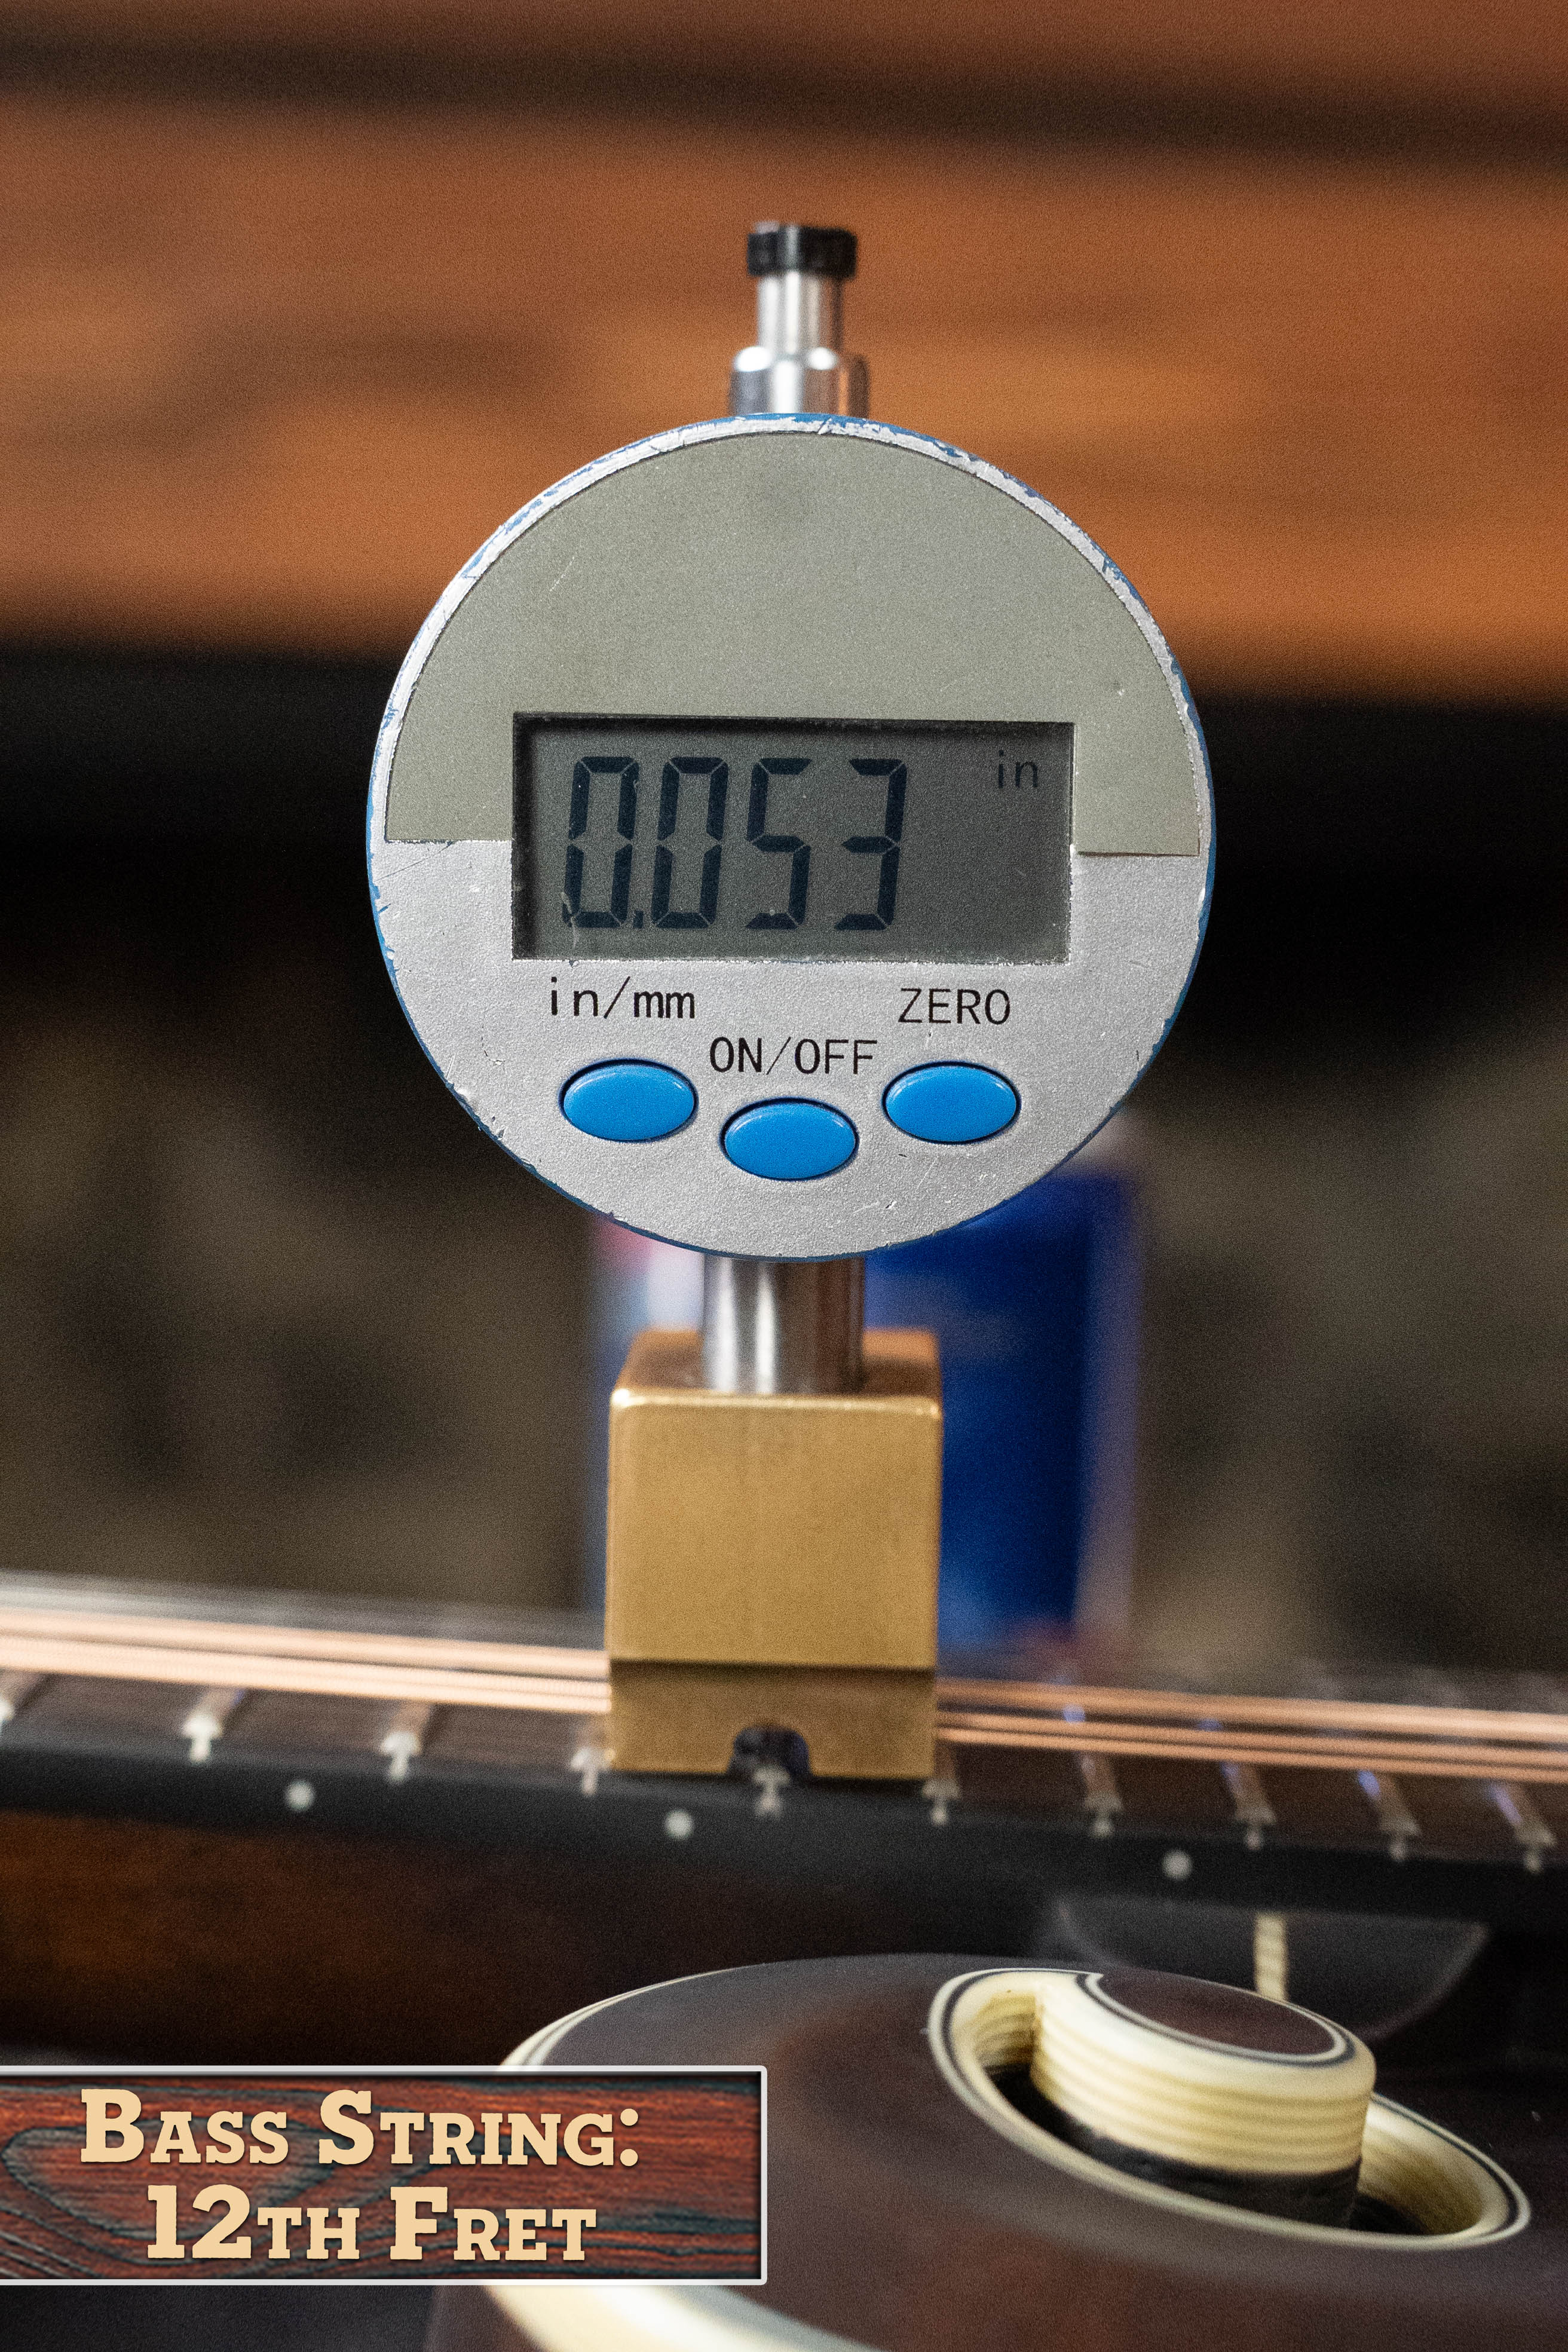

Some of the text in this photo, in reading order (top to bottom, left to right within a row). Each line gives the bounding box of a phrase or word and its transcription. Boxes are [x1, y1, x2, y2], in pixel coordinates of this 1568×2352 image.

[996, 749, 1040, 789] in
[562, 757, 908, 930] 0.053
[550, 976, 696, 1019] in/mm
[898, 987, 1011, 1025] ZERO
[709, 1036, 878, 1075] ON/OFF
